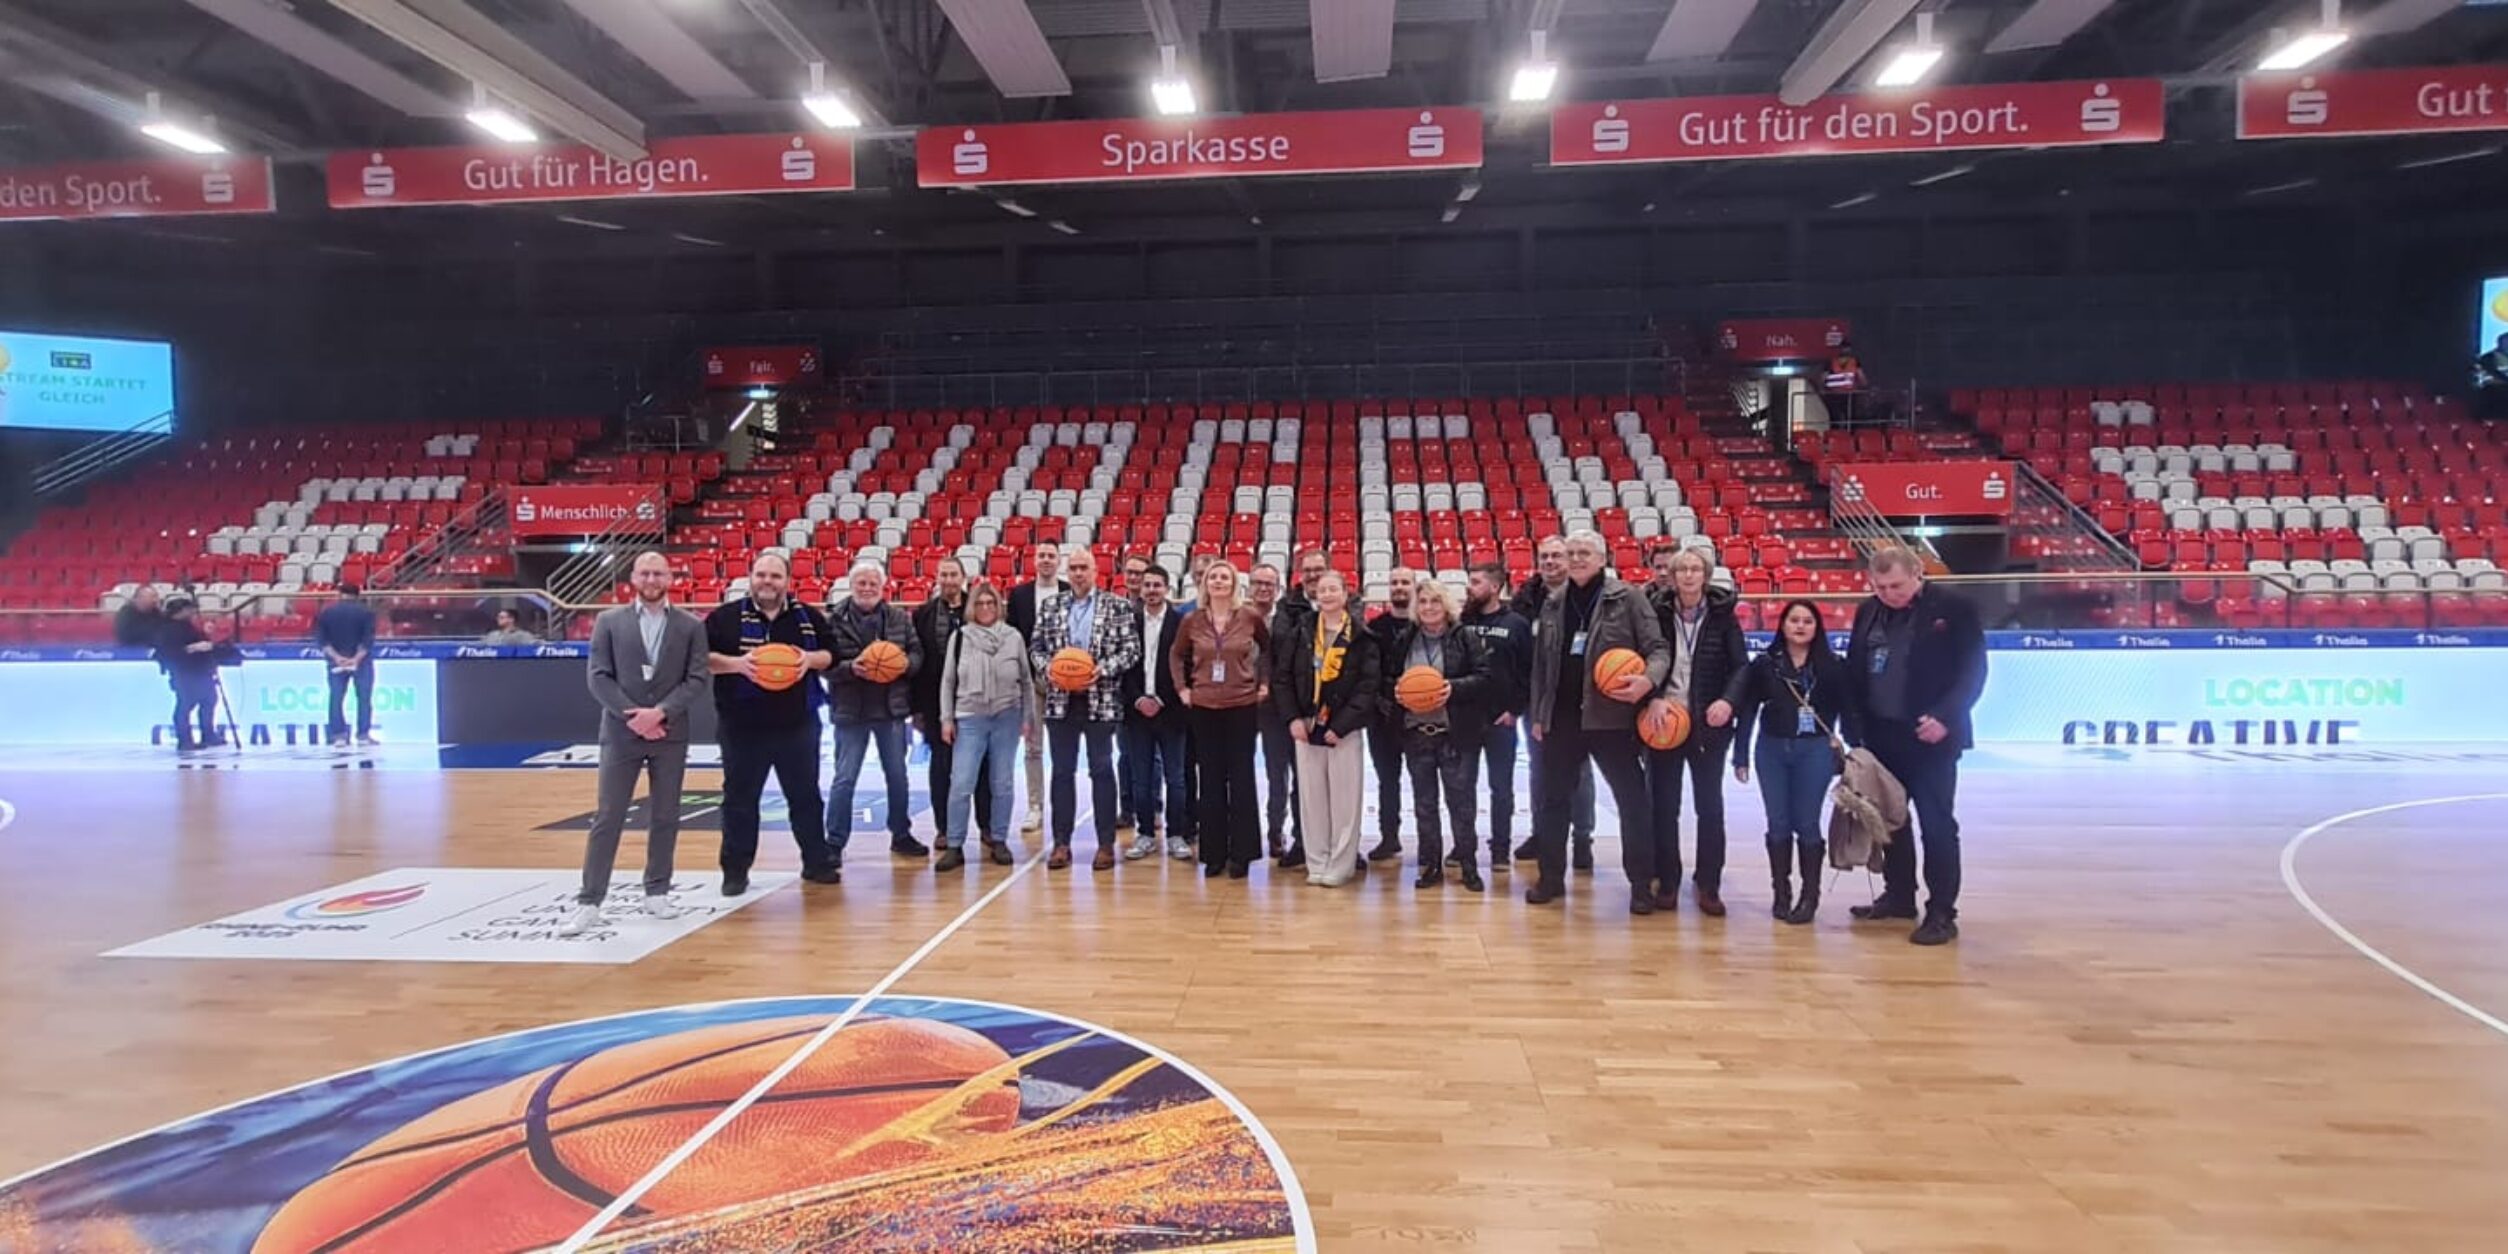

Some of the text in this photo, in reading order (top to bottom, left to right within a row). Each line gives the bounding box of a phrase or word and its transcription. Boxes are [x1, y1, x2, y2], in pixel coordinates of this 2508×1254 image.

[2418, 82, 2493, 117] Gut
[1678, 98, 2030, 146] Gut für den Sport.
[1102, 131, 1290, 167] Sparkasse
[464, 156, 709, 192] Gut für Hagen.
[65, 172, 163, 212] Sport.
[1766, 333, 1798, 347] Nah.
[1905, 482, 1944, 500] Gut.
[540, 504, 632, 520] Menschlich.
[2034, 637, 2074, 648] Thalia
[2131, 637, 2171, 647] Thalia
[2226, 636, 2267, 646] Thalia
[2327, 635, 2368, 646] Thalia
[2428, 635, 2470, 645] Thalia
[466, 647, 498, 657] Thalia
[545, 646, 578, 657] Thalia
[2205, 678, 2405, 707] LOCATION
